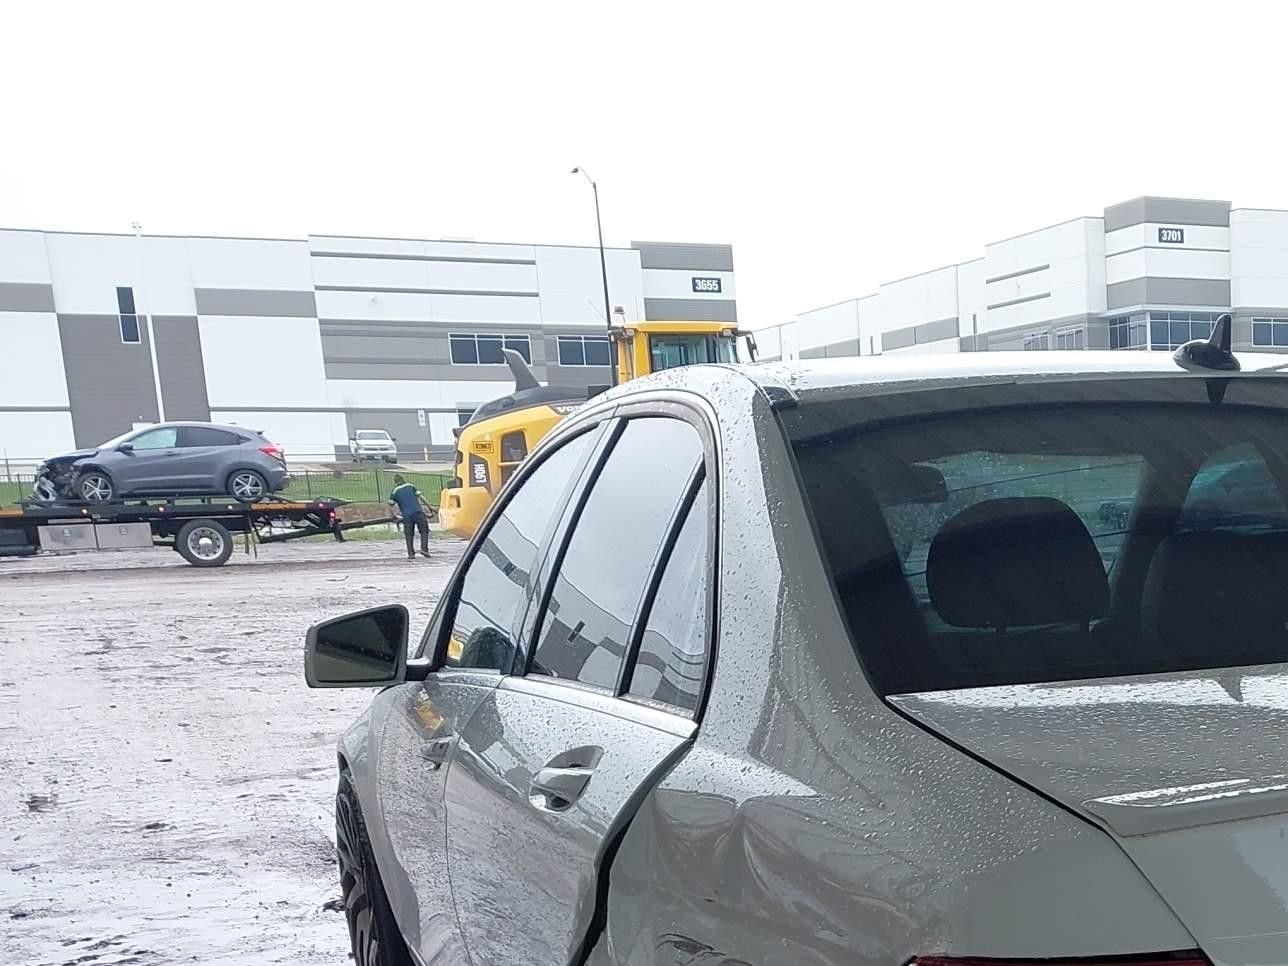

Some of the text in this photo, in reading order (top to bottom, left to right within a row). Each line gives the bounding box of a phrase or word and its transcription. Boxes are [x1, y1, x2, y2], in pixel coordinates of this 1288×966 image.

[1161, 229, 1182, 242] 3701
[695, 279, 719, 291] 3655
[473, 463, 487, 483] L90H
